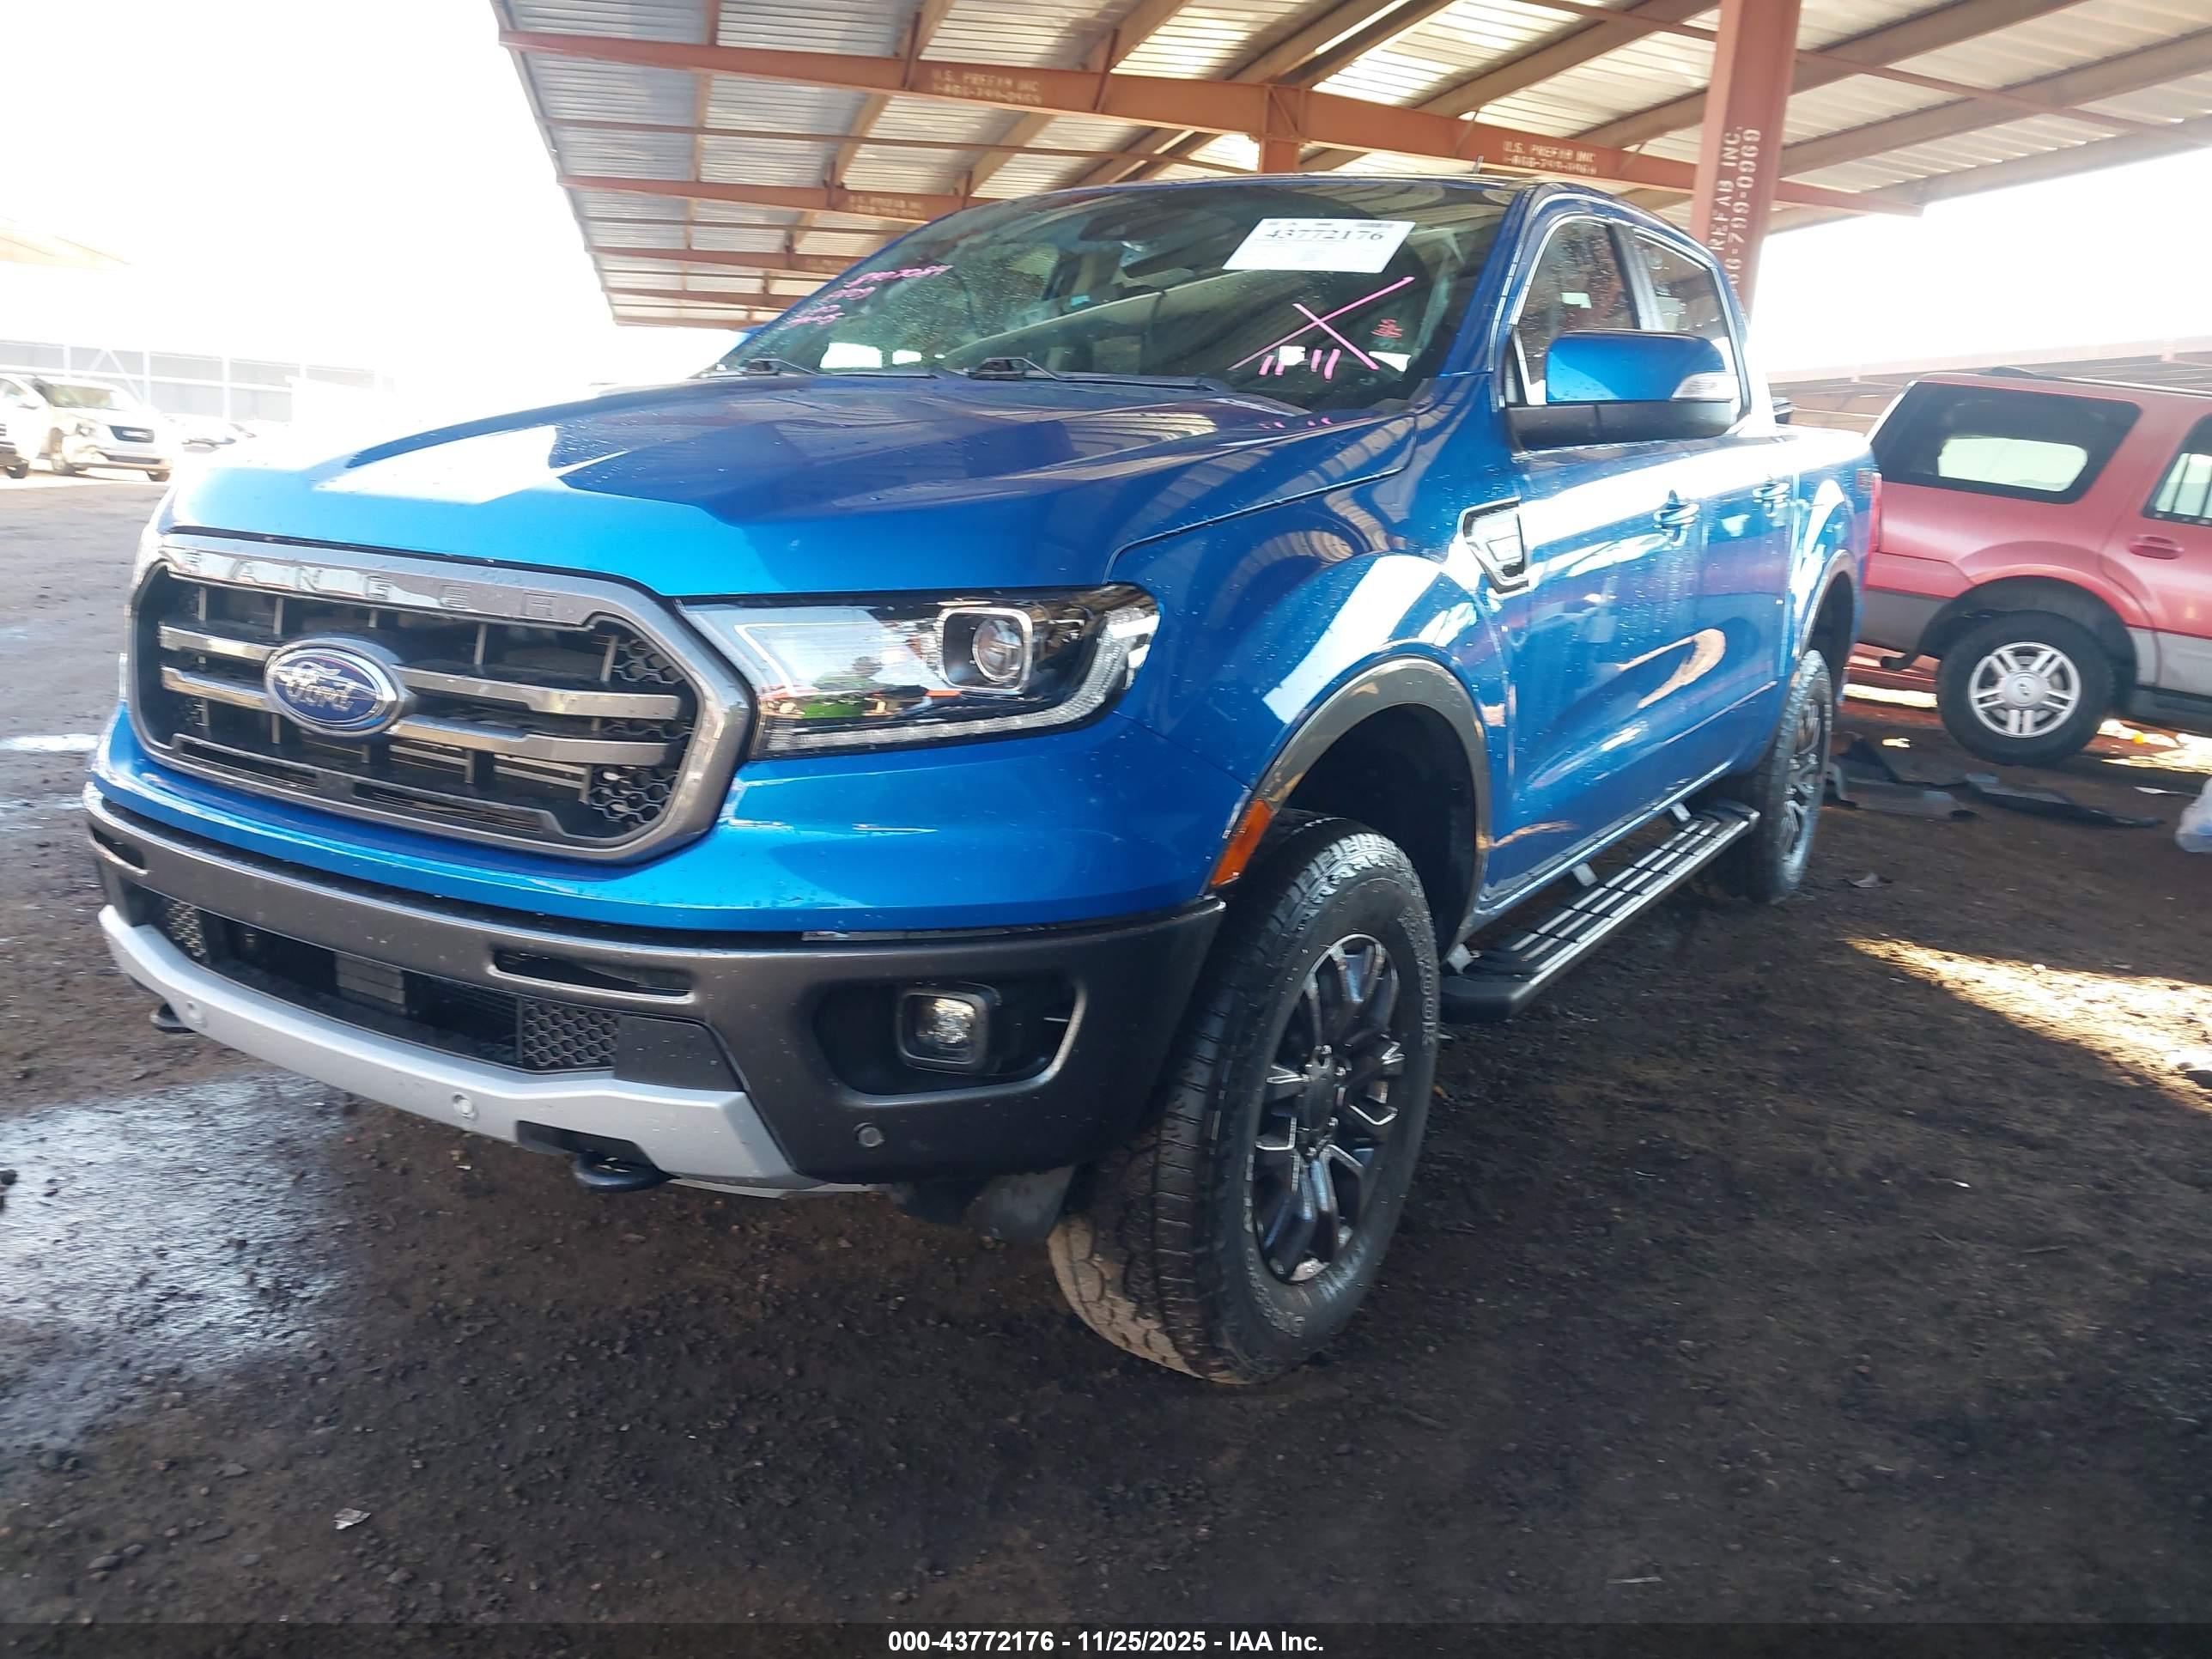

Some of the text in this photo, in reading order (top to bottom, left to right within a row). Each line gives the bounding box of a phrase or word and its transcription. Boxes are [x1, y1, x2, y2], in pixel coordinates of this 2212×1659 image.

[1266, 228, 1385, 241] 43772176
[1708, 179, 1735, 252] REFAB
[184, 548, 557, 617] RANGER
[276, 660, 355, 712] Ford
